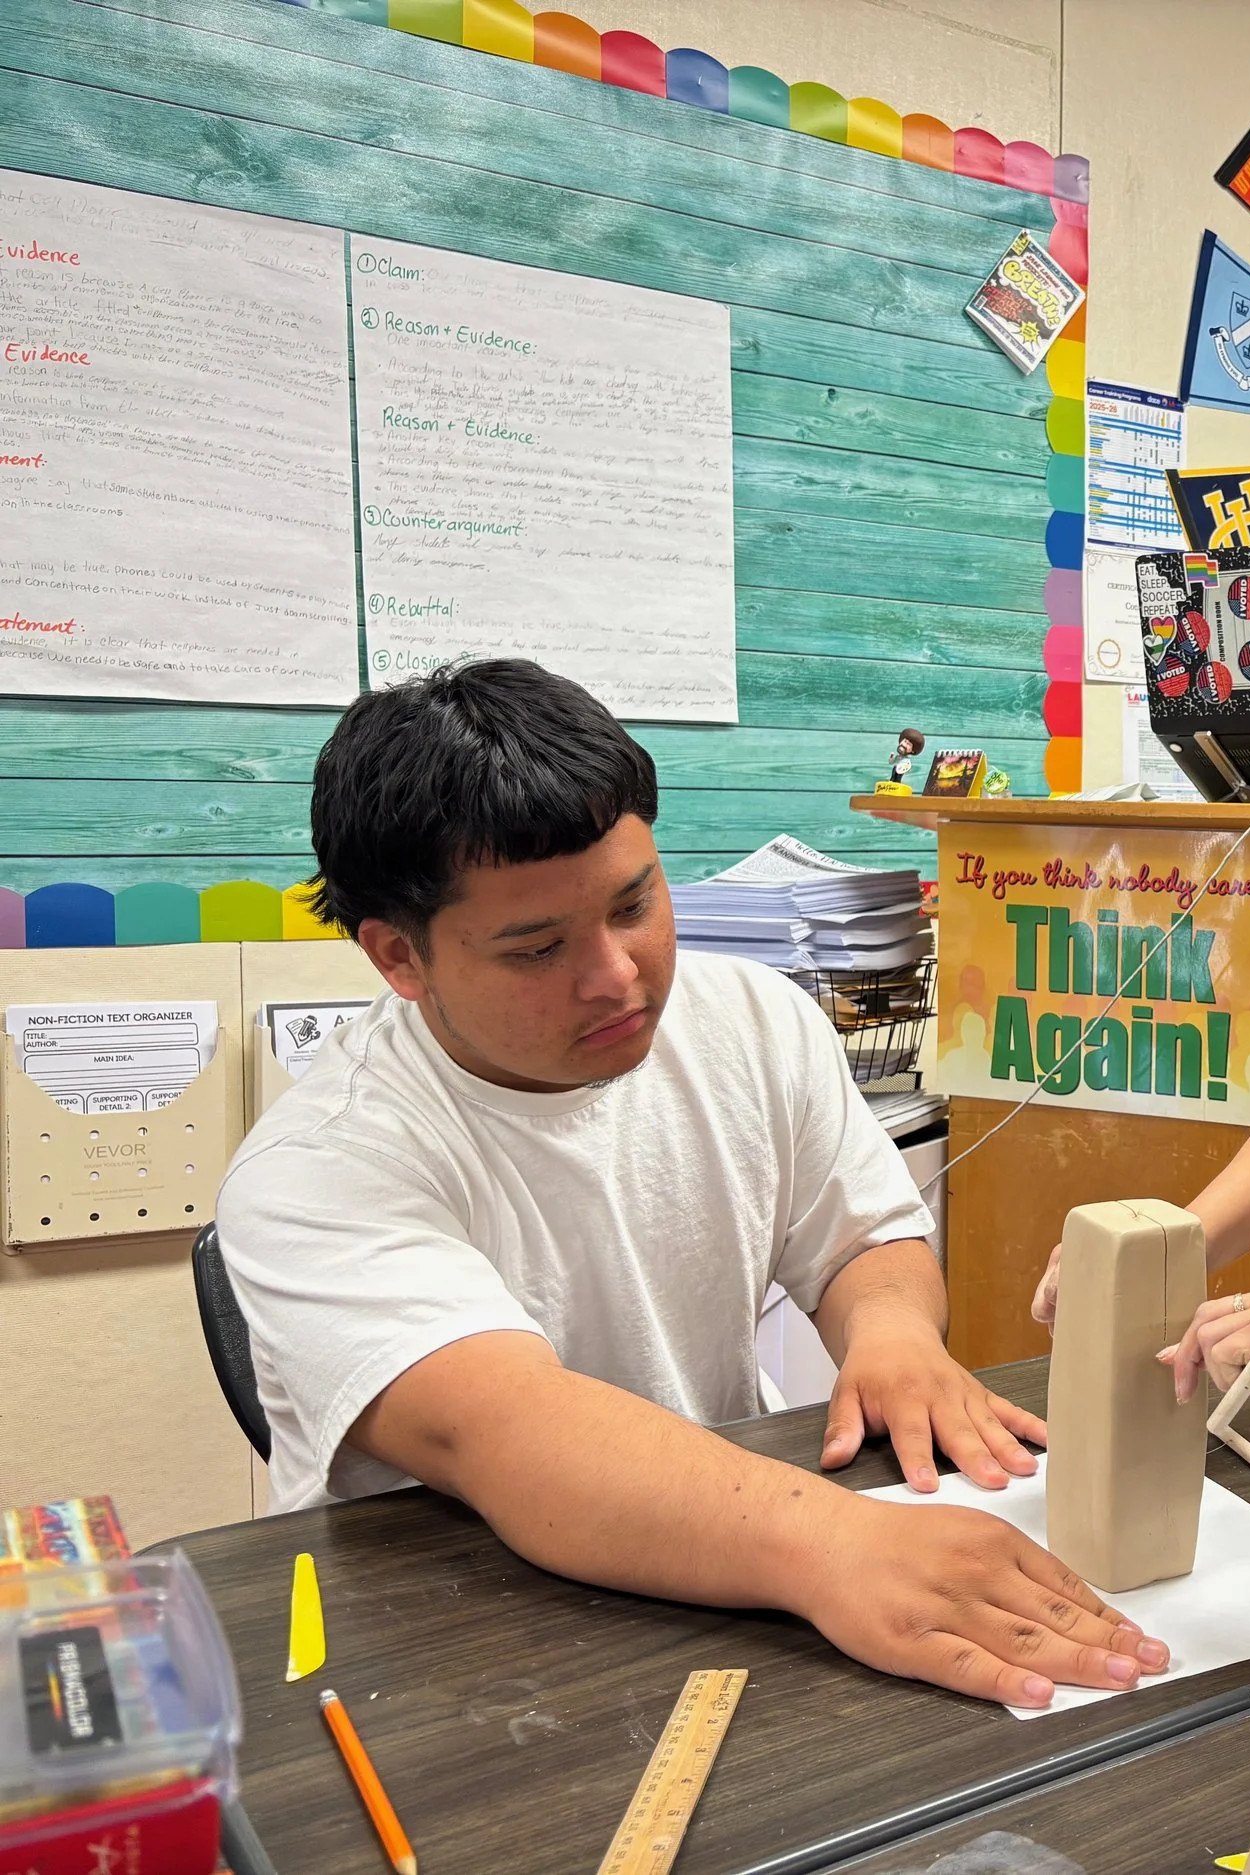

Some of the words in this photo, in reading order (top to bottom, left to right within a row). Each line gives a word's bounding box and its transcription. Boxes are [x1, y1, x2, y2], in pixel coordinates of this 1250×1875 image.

[1234, 169, 1250, 195] UT
[385, 311, 439, 336] Reason
[457, 325, 538, 355] Evidence:
[4, 342, 91, 367] Evidence
[383, 405, 439, 433] Reason
[465, 419, 540, 446] Evidence:
[383, 508, 528, 541] Counterargument:
[31, 562, 54, 576] may
[64, 560, 77, 573] be
[115, 564, 155, 578] phones
[161, 571, 193, 582] could
[199, 573, 212, 583] be
[216, 576, 237, 588] used
[1140, 566, 1157, 576] EAT.
[25, 577, 100, 594] concentrate
[103, 586, 116, 595] on
[1141, 578, 1169, 590] SLEEP.
[1239, 578, 1249, 613] VOTED
[387, 595, 461, 618] Rebuttal:
[1142, 590, 1186, 603] SOCCER.
[100, 636, 129, 648] clear
[138, 636, 168, 650] that
[1181, 616, 1198, 648] VOTED
[1217, 619, 1226, 662] COMPOSITION
[1160, 665, 1186, 679] VOTED
[1206, 664, 1217, 698] VOTED
[1127, 693, 1150, 702] LAU
[956, 852, 988, 889] If
[992, 870, 1037, 900] you
[1042, 858, 1102, 889] think
[1107, 863, 1198, 910] nobody
[1006, 904, 1216, 1004] Think
[28, 1014, 104, 1025] NON-FICTION
[107, 1013, 131, 1022] TEXT
[133, 1011, 193, 1021] ORGANIZER
[26, 1032, 48, 1040] TITLE:
[26, 1040, 59, 1048] AUTHOR:
[94, 1055, 114, 1063] MAIN
[115, 1054, 135, 1062] IDEA:
[990, 995, 1231, 1101] Again!
[92, 1095, 138, 1104] SUPPORTING
[83, 1143, 146, 1159] VEVOR
